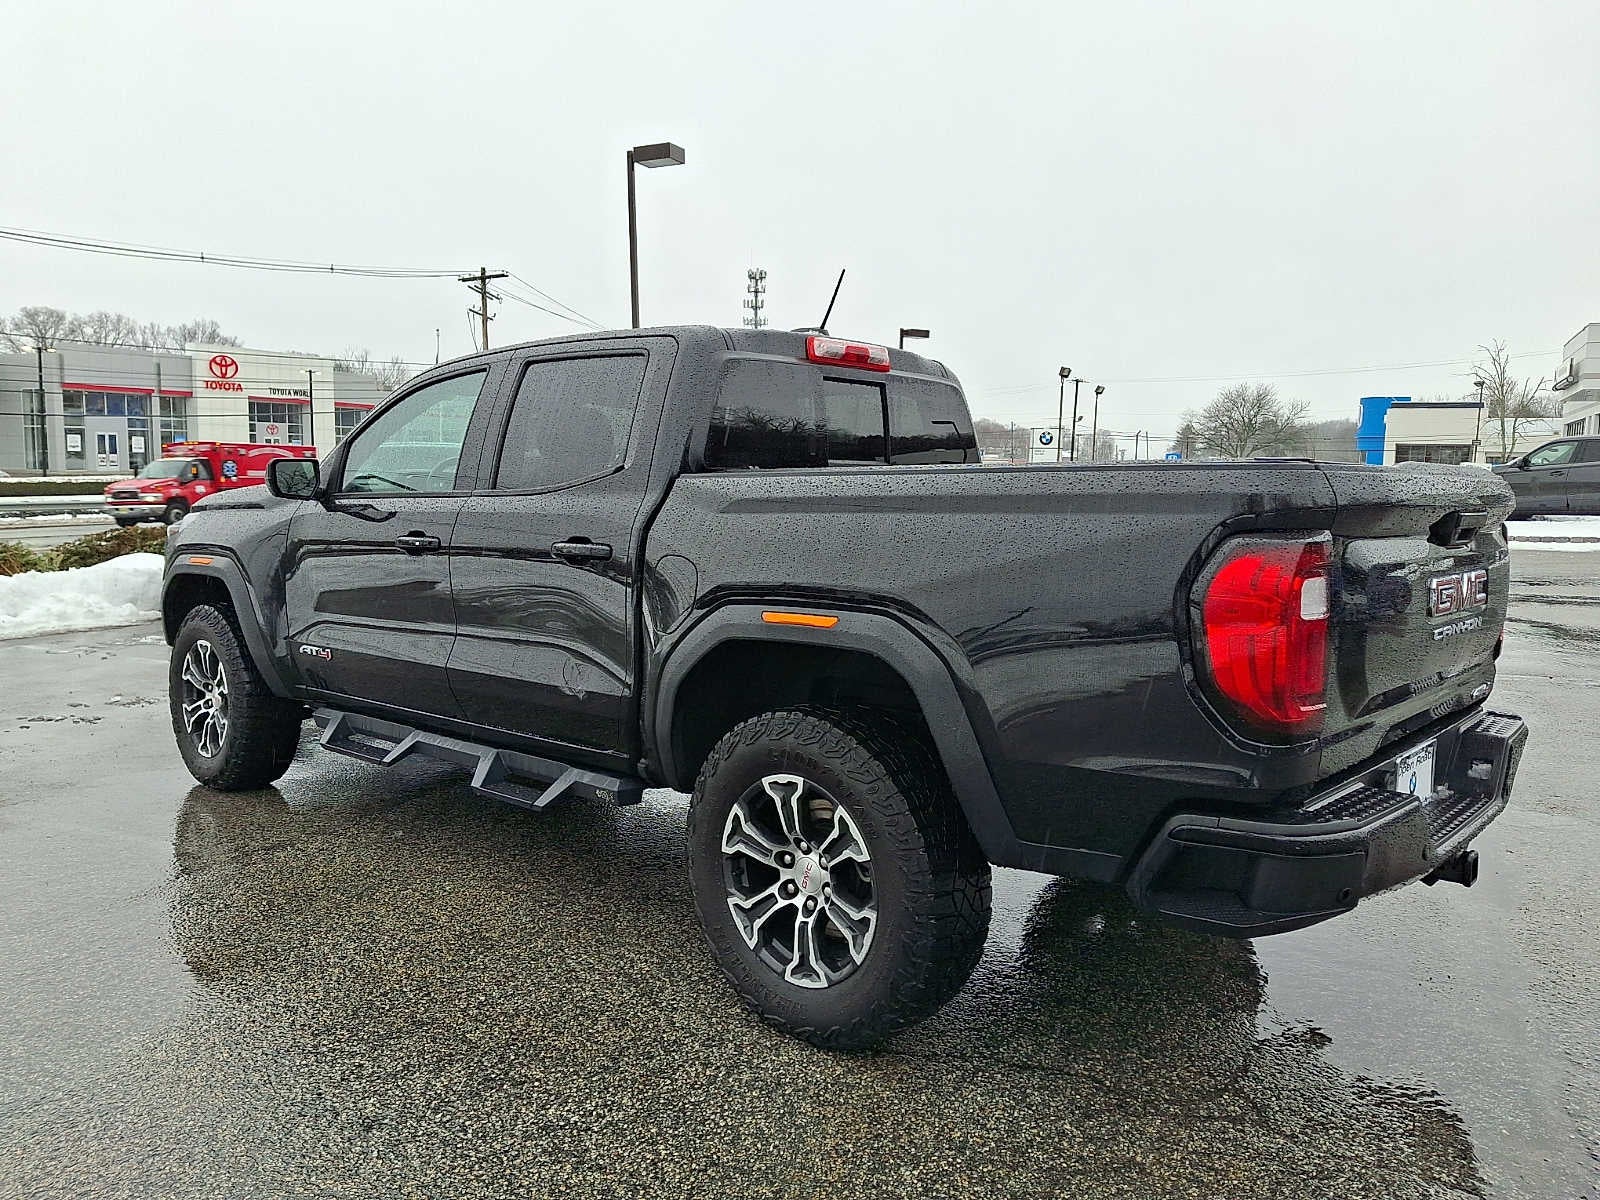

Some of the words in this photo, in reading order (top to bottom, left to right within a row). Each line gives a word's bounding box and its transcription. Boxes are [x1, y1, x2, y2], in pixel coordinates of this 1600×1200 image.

[204, 380, 243, 392] TOYOTA
[268, 387, 292, 397] TOYOTA
[293, 389, 311, 398] WORL
[1430, 569, 1488, 616] GMC
[1433, 616, 1482, 640] CANYON
[299, 644, 332, 662] AT4
[801, 862, 813, 889] GMC
